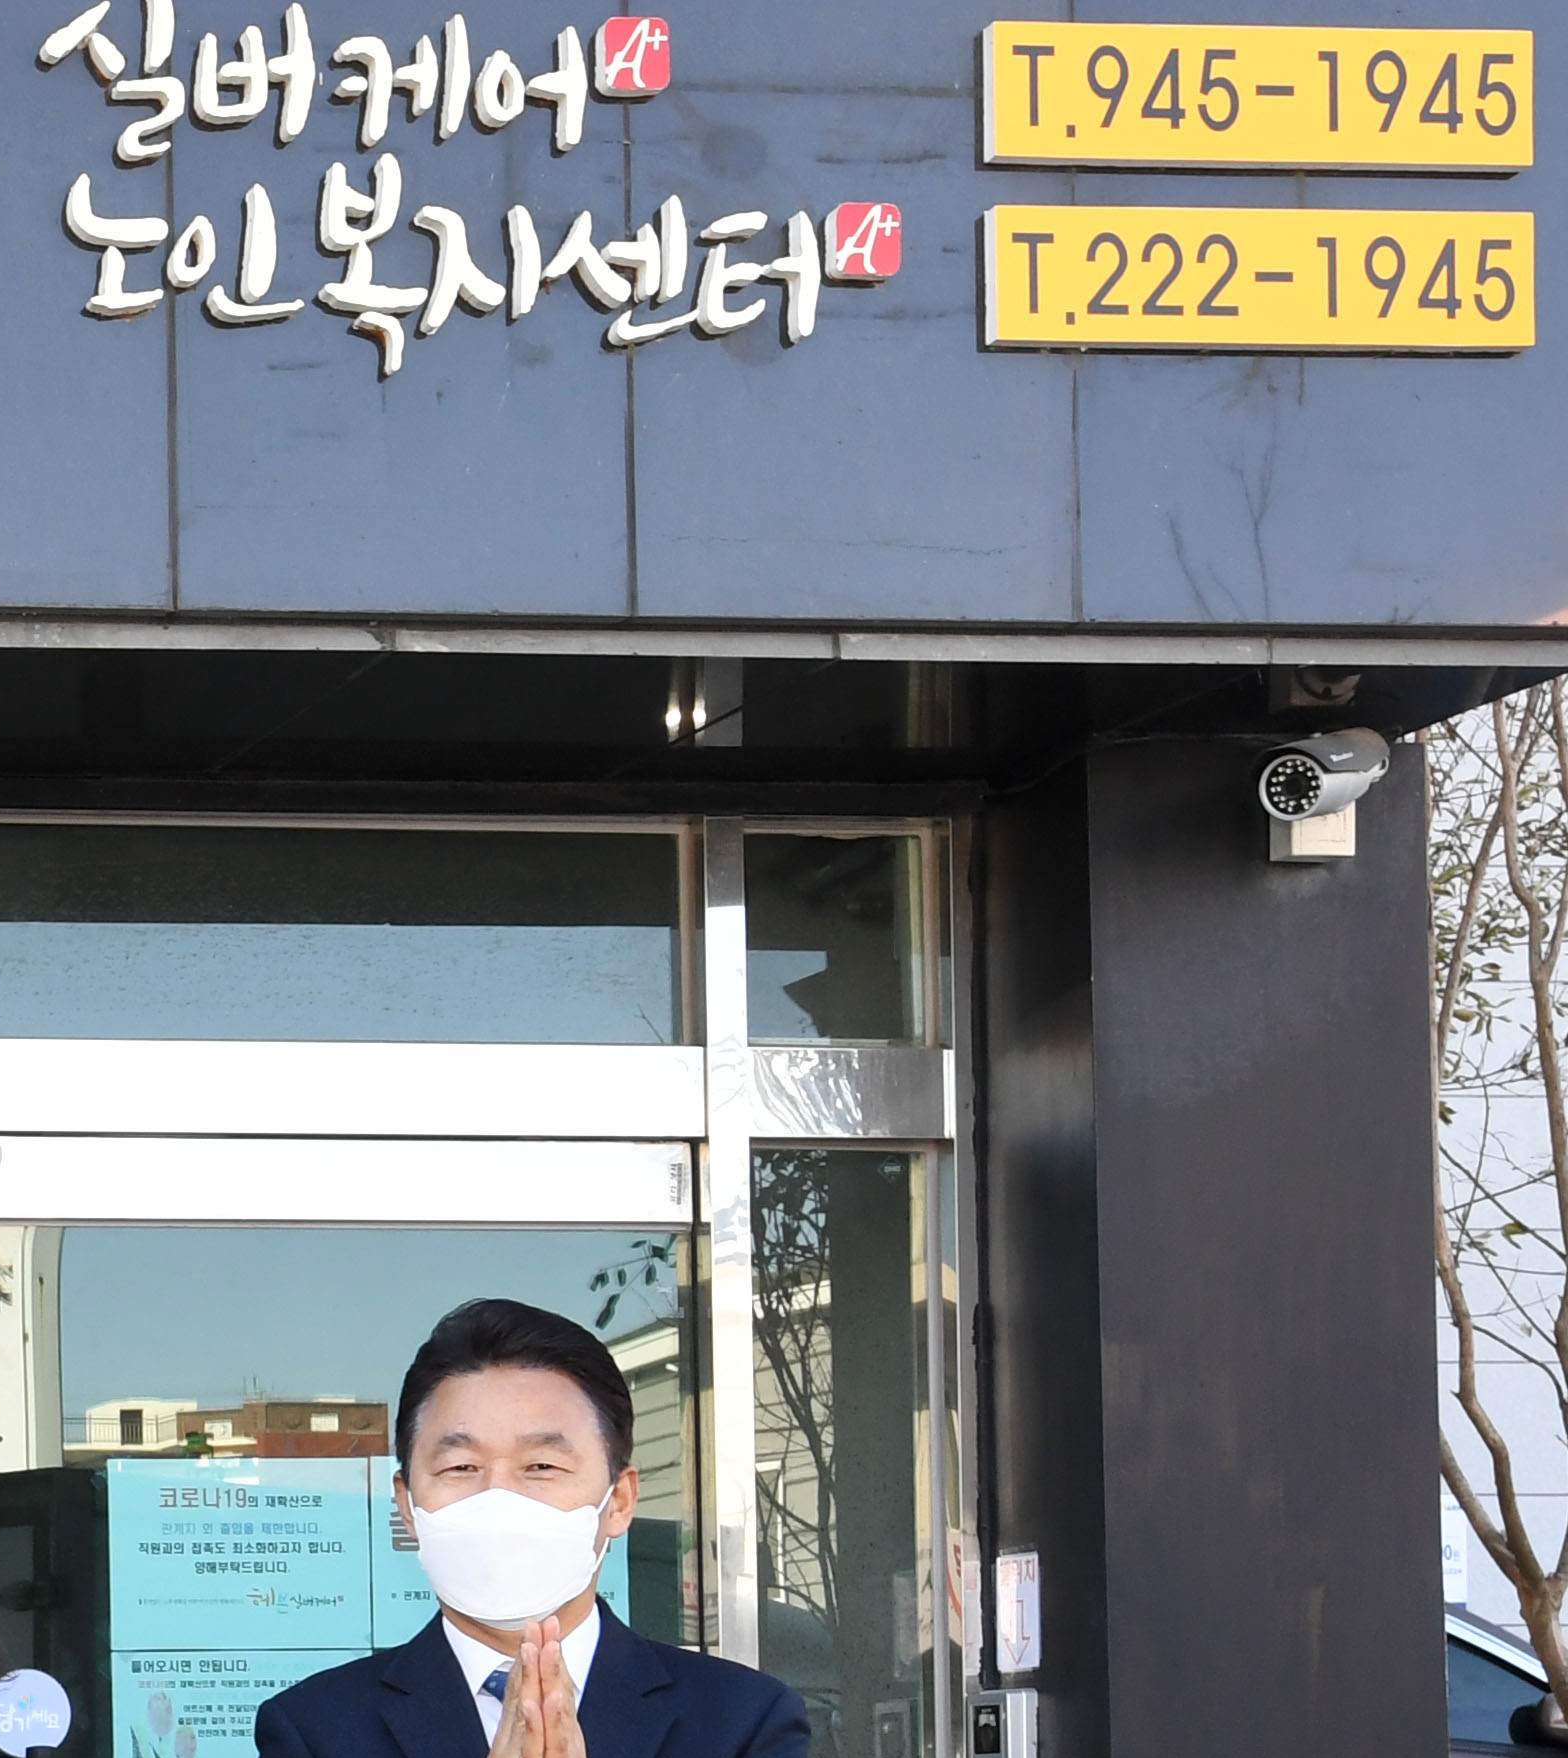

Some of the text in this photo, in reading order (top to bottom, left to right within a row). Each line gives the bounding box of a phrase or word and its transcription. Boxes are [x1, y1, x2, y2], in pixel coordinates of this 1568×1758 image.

[37, 0, 590, 163] 실버케어
[1011, 43, 1518, 139] T.945-1945
[1010, 230, 1517, 326] T.222-1945
[159, 1487, 323, 1509] 코로나19의 재확산으로
[138, 1542, 185, 1555] 직원과의
[194, 1561, 291, 1574] 양해부탁드립니다.
